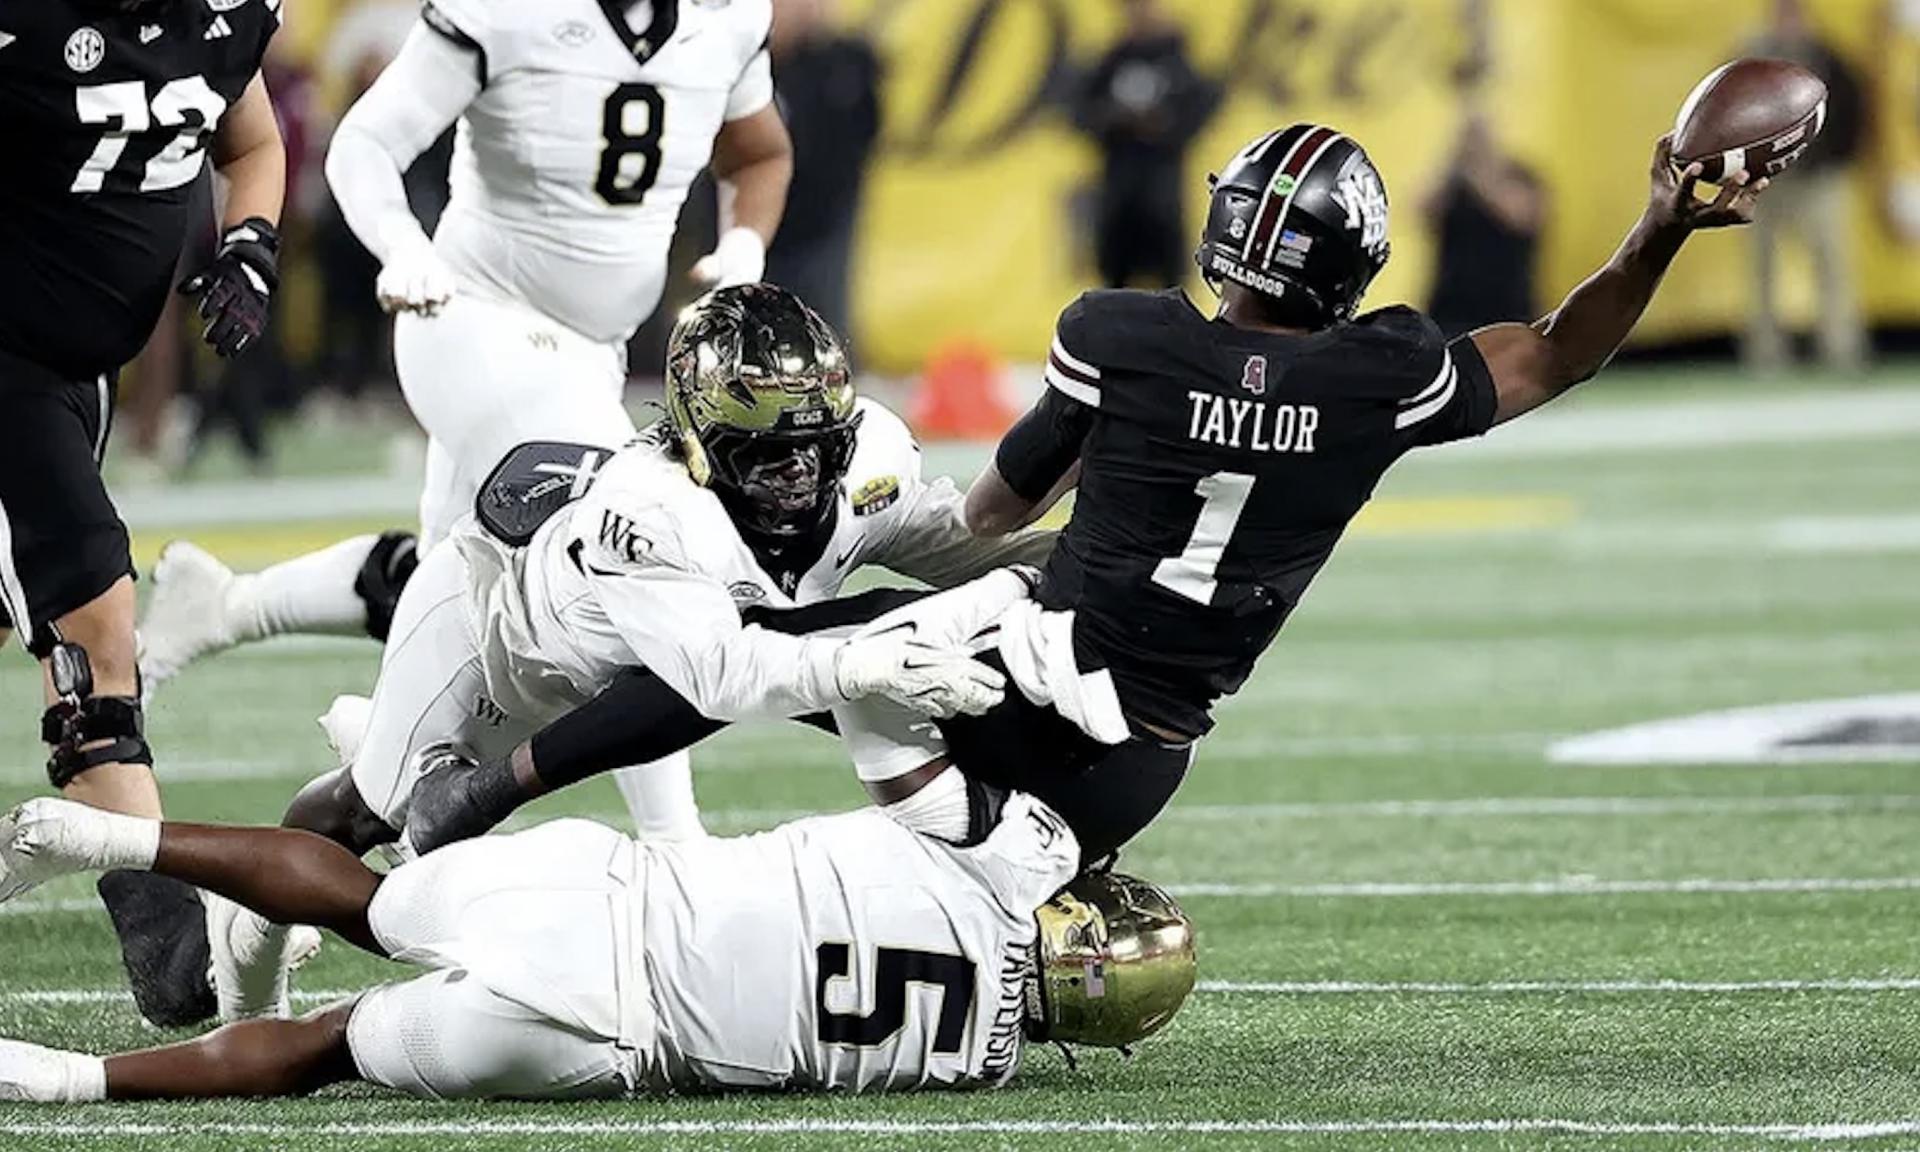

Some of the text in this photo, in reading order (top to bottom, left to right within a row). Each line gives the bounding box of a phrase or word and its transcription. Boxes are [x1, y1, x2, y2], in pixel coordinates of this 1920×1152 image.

[65, 28, 103, 71] SEC
[69, 75, 227, 192] 72
[594, 83, 665, 205] 8
[1211, 254, 1285, 298] BULLDOGS
[1187, 390, 1319, 453] TAYLOR
[598, 509, 653, 564] WF
[1151, 471, 1256, 606] 1
[476, 693, 509, 727] WF
[817, 941, 978, 1057] 5
[1025, 977, 1044, 1021] FOREST
